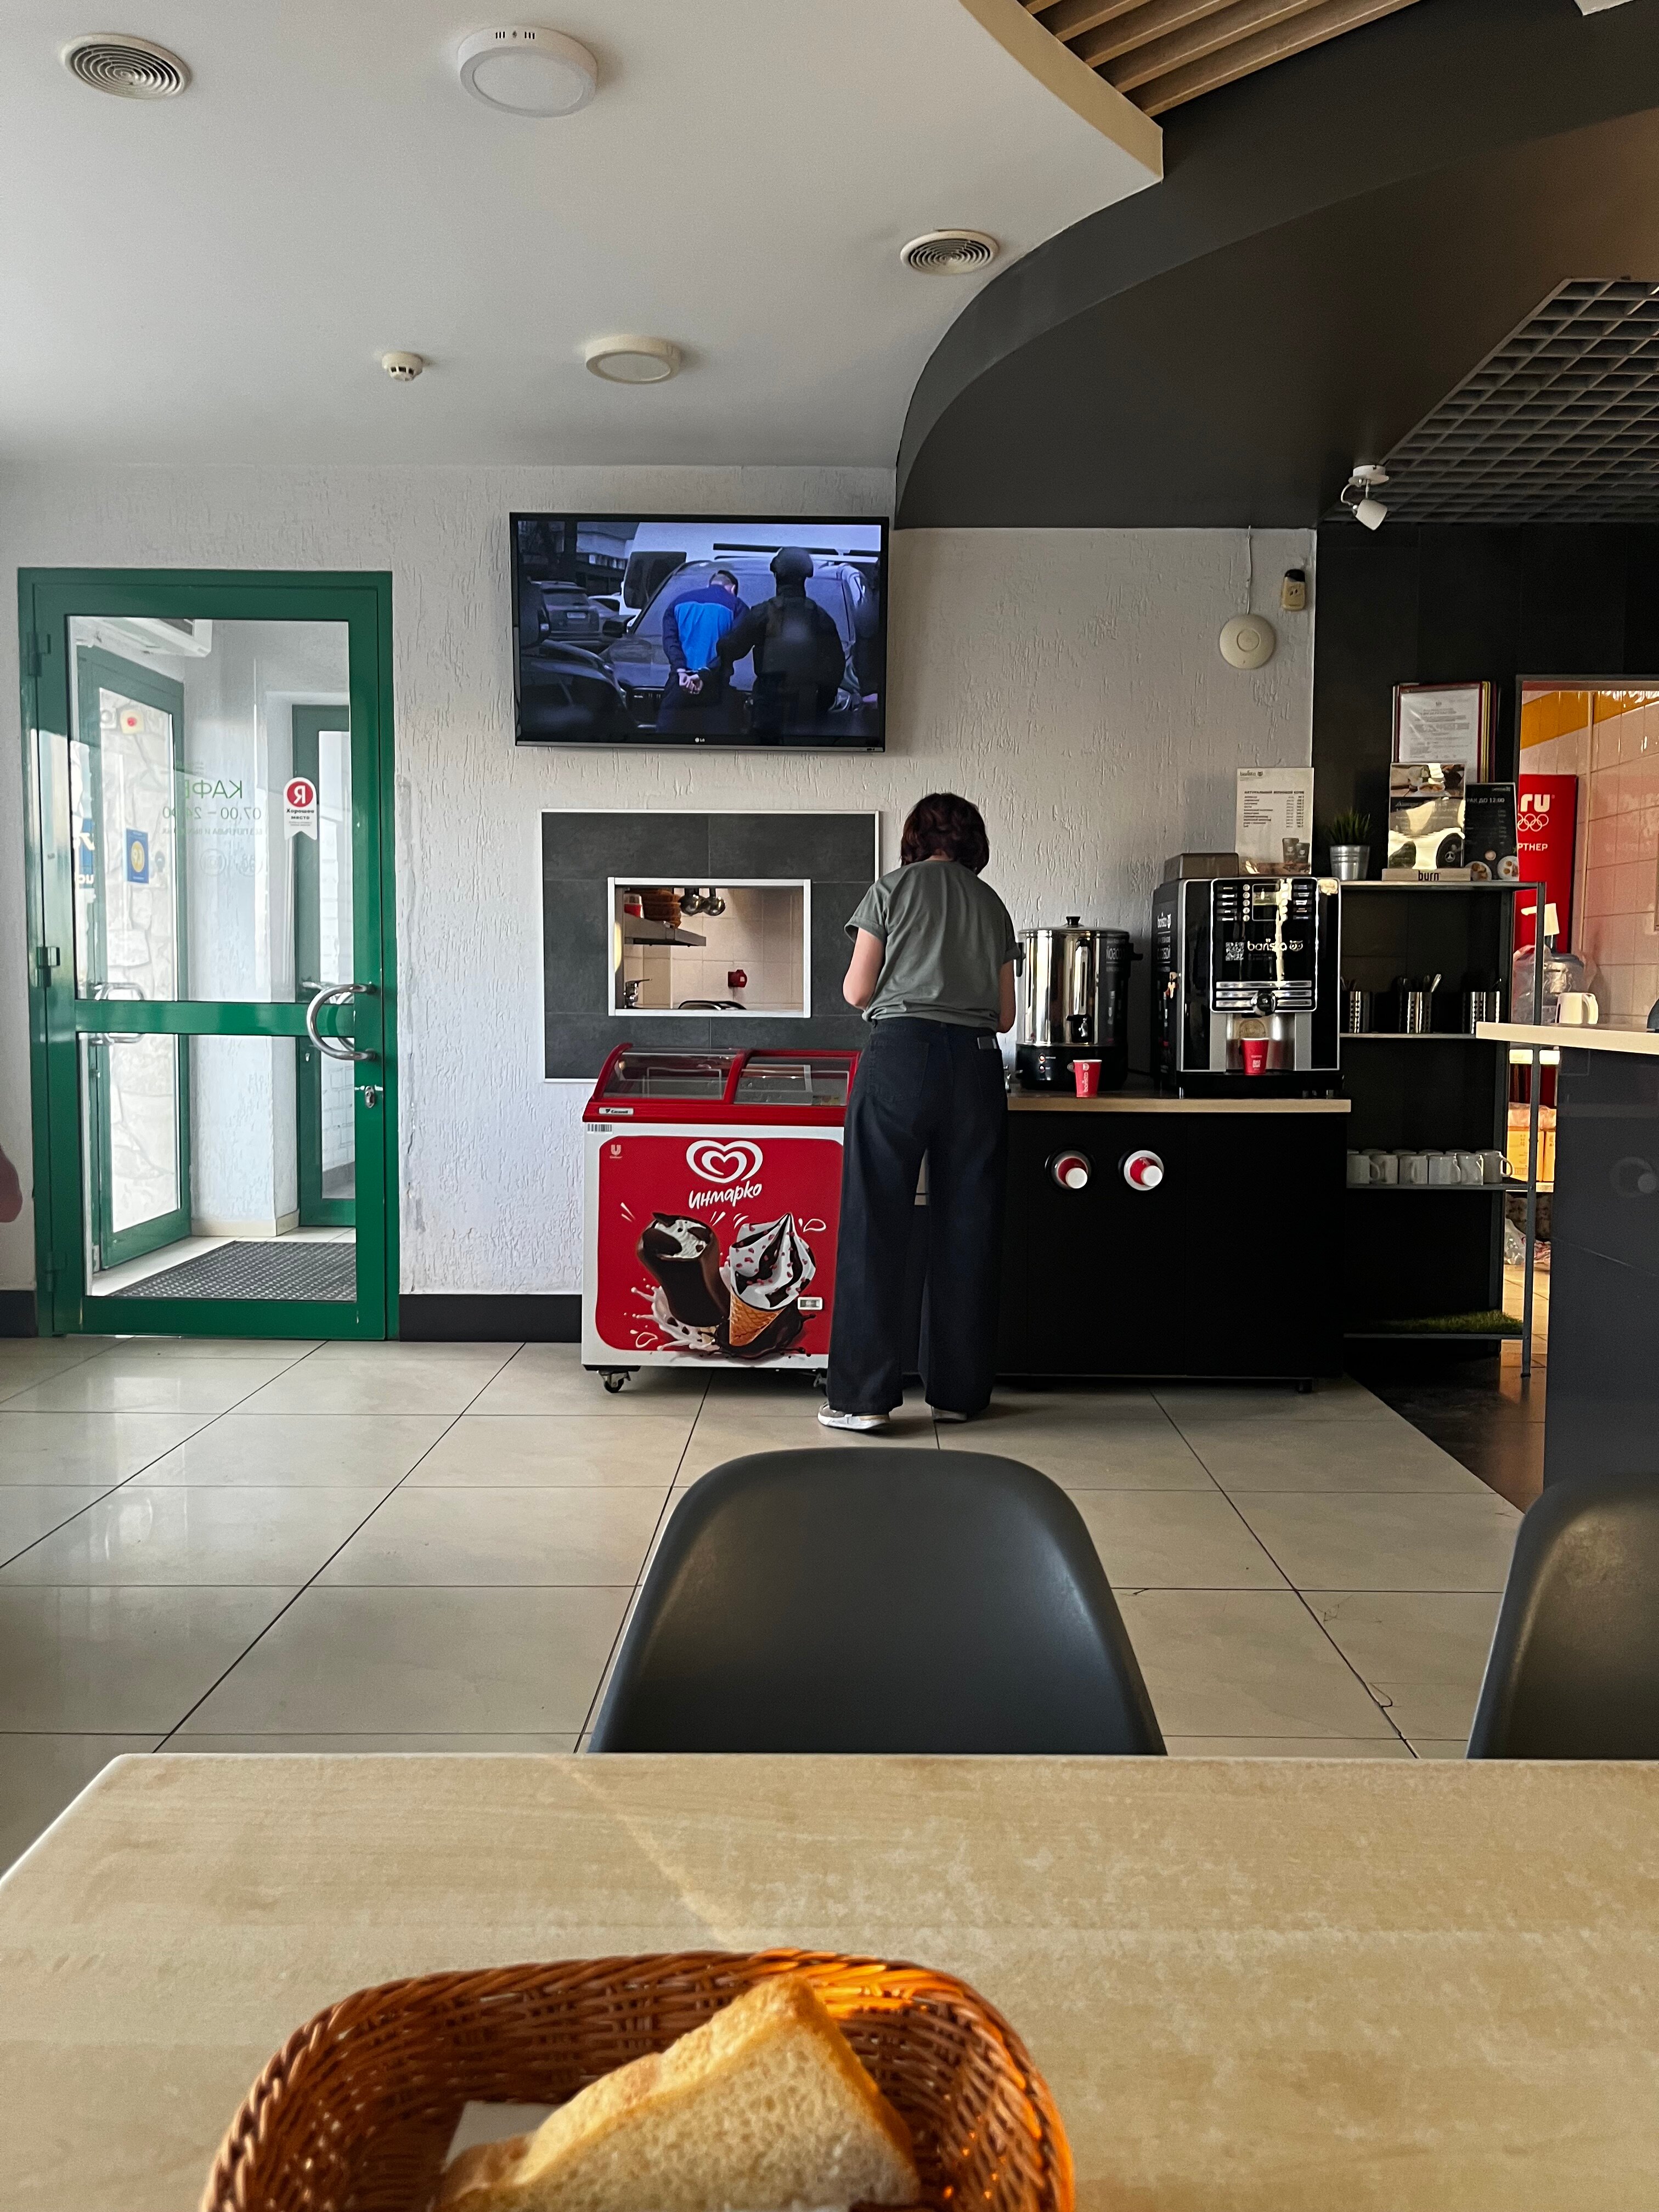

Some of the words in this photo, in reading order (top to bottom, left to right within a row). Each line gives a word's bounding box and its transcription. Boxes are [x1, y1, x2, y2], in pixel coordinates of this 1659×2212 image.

[294, 785, 306, 804] Я
[1520, 793, 1550, 812] ru
[1517, 842, 1548, 851] РТНЕР
[1418, 871, 1439, 881] burn
[1247, 938, 1288, 951] barisa
[689, 1181, 763, 1210] Инмарко
